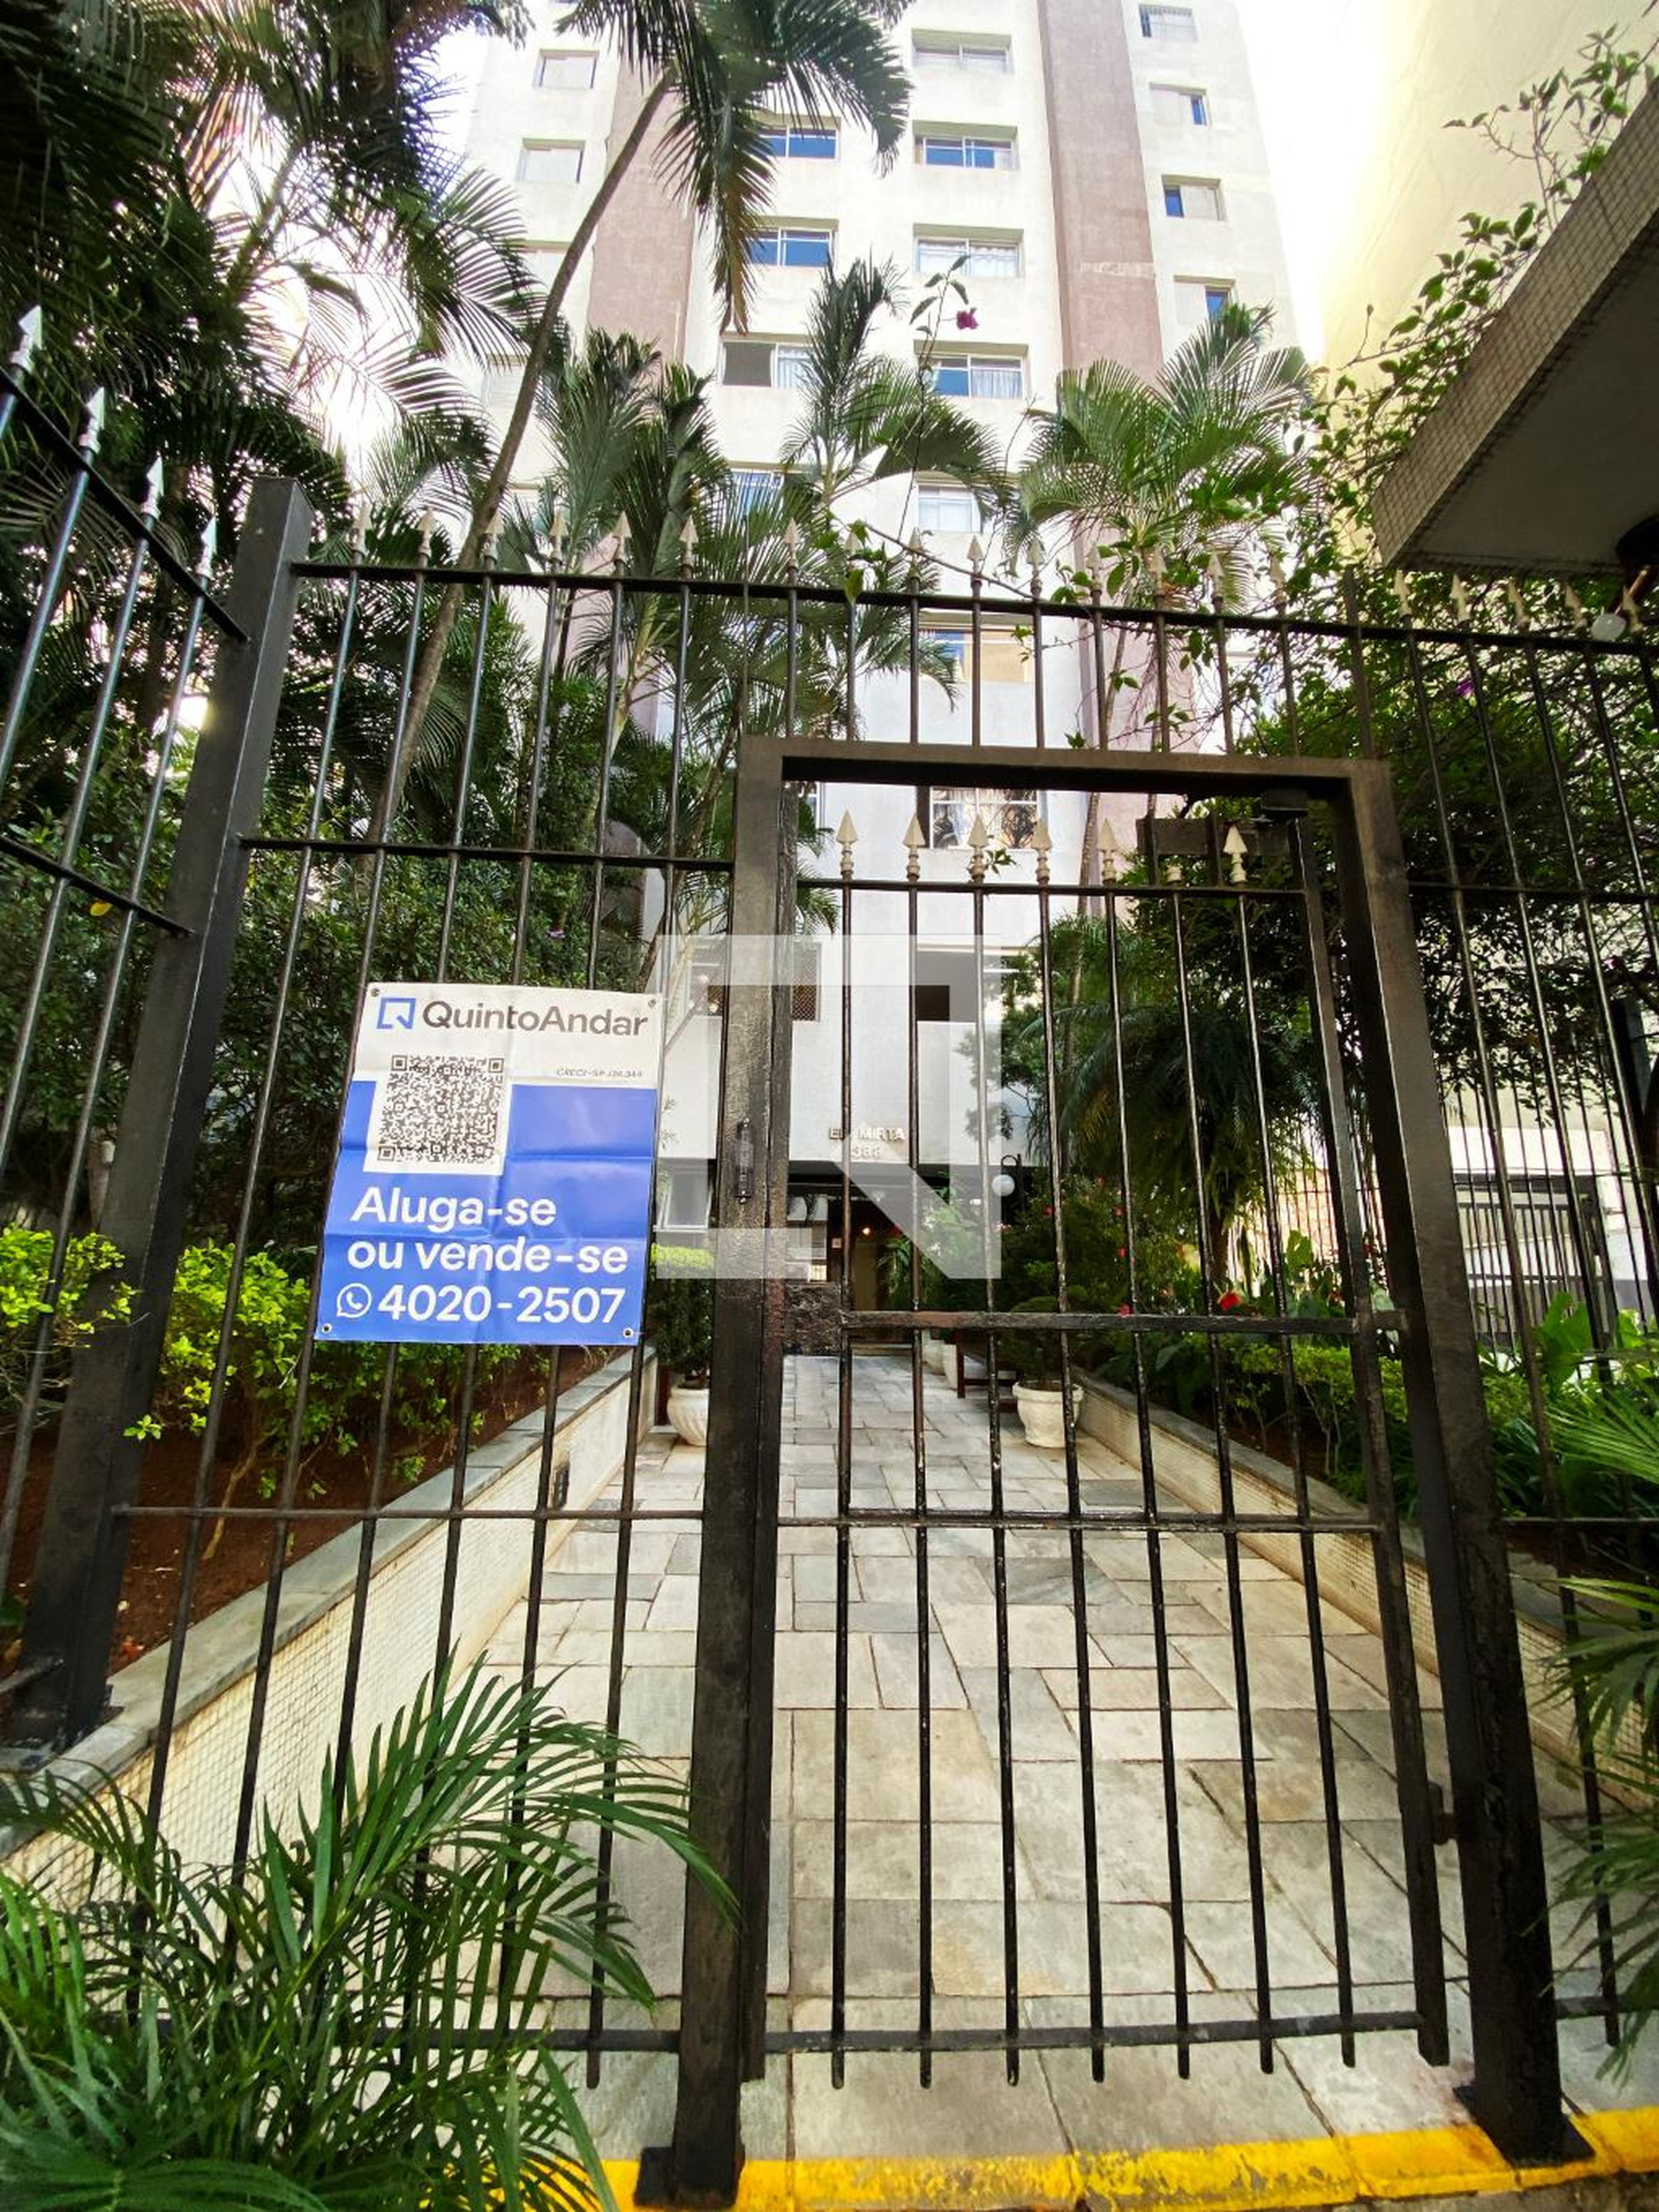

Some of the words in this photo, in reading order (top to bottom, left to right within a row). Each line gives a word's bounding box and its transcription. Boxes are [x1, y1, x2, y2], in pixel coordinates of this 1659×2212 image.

[423, 1000, 649, 1036] QuintoAndar
[350, 1187, 556, 1232] Aluga-se
[347, 1243, 403, 1270] ou
[416, 1237, 628, 1272] vende-se
